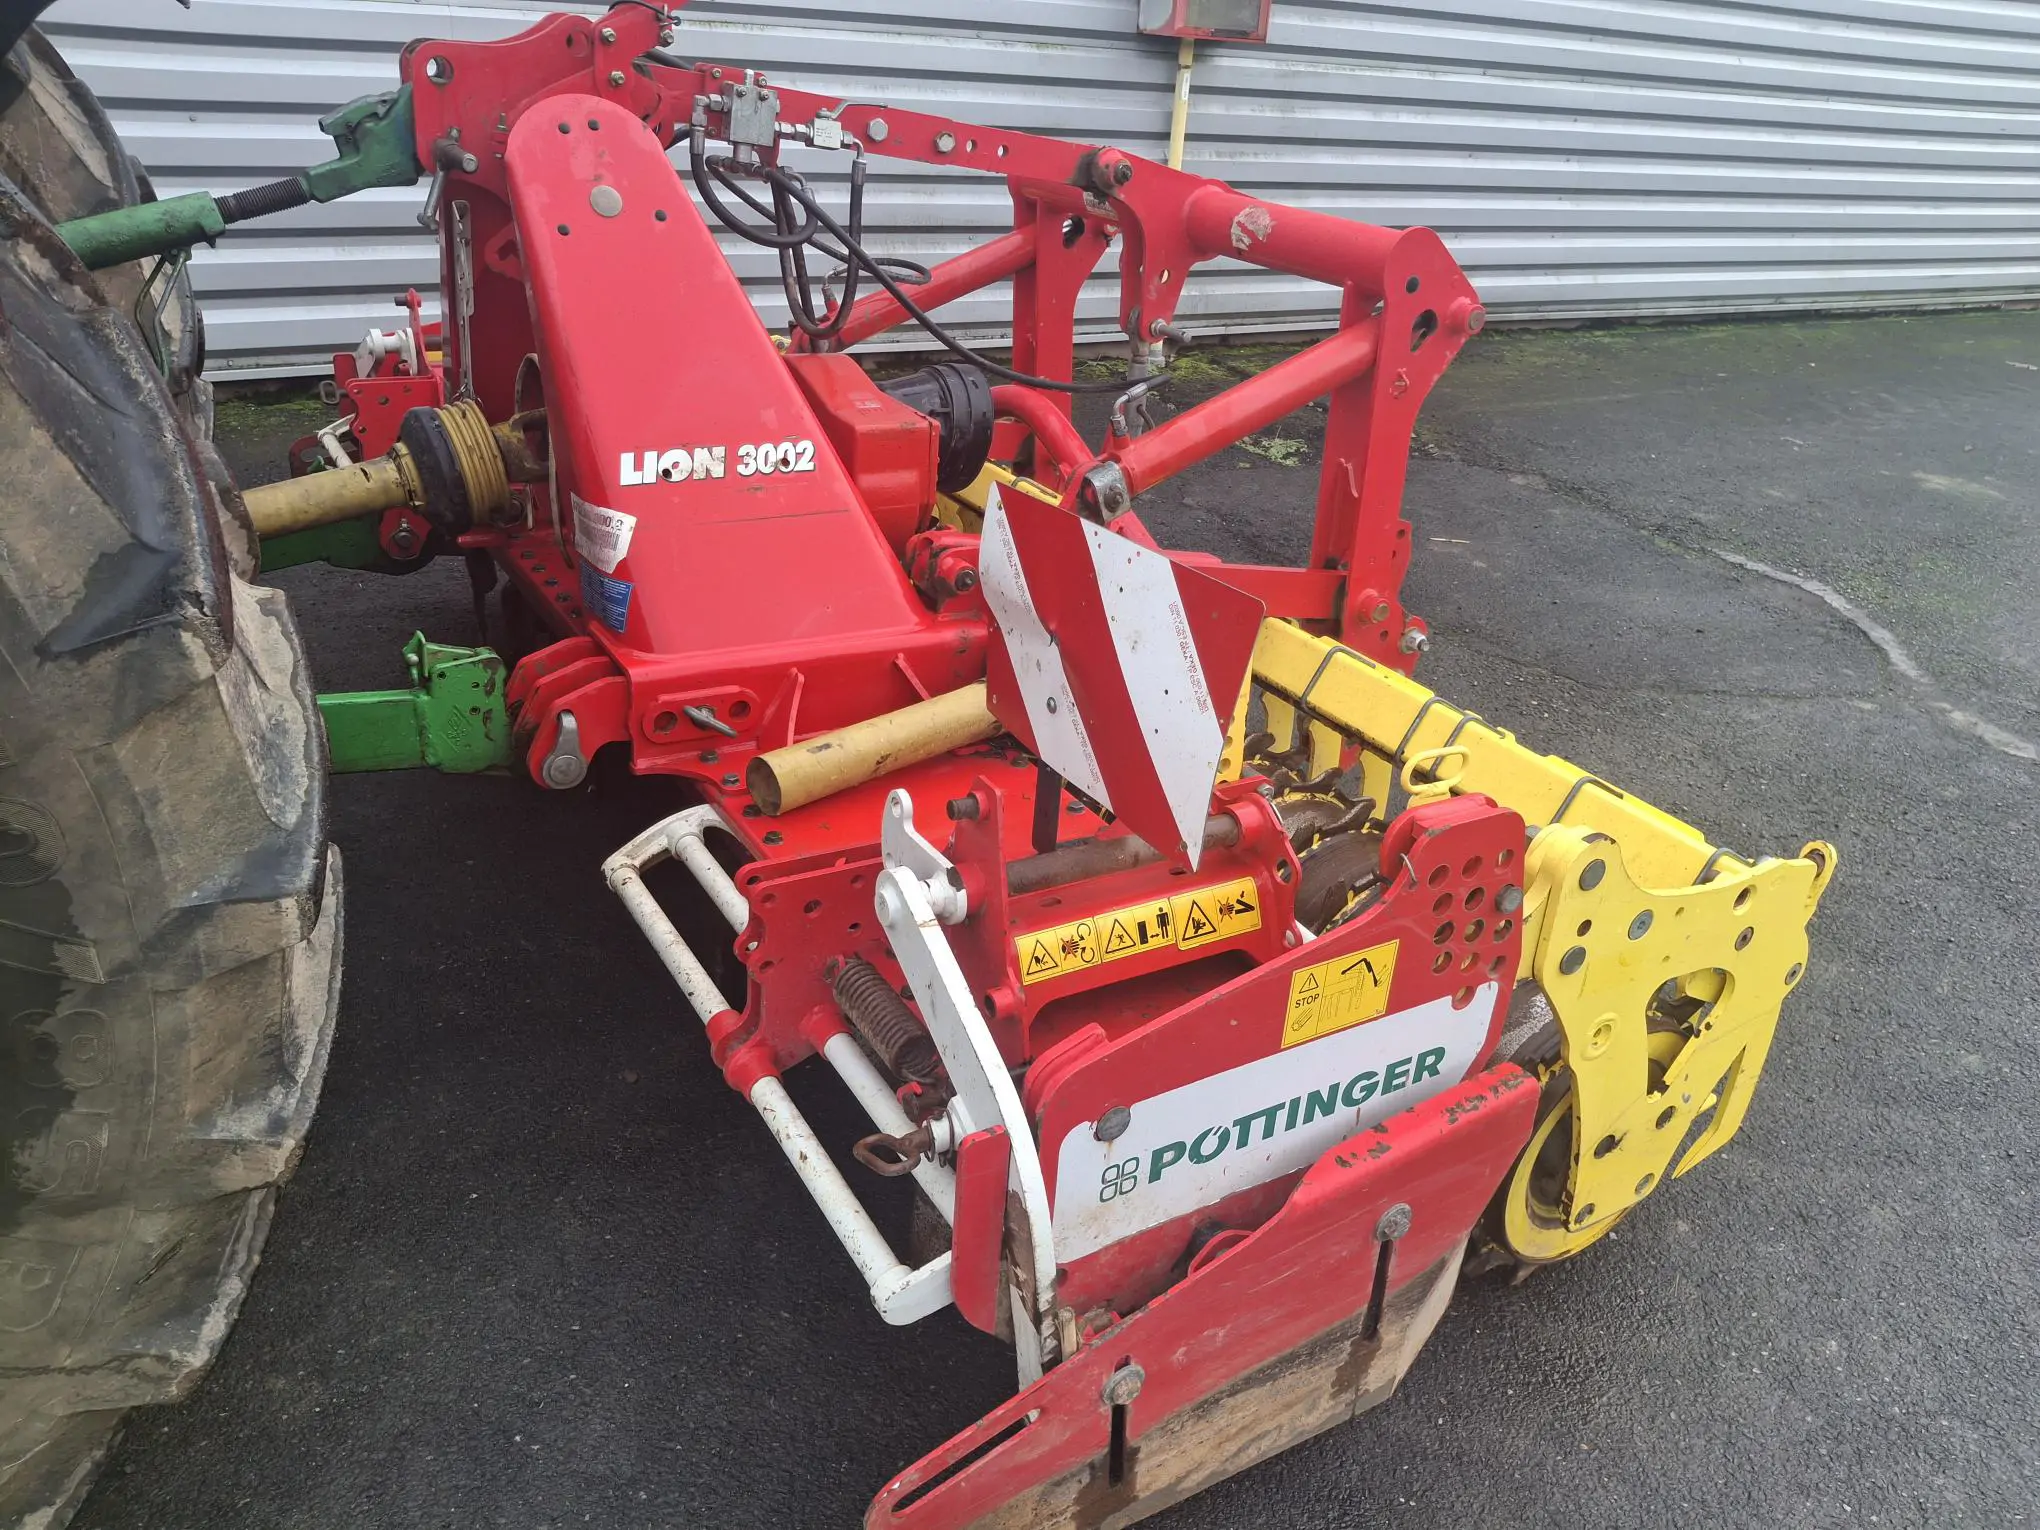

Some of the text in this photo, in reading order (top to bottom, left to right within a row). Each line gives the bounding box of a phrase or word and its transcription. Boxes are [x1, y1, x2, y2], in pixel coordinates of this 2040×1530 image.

[620, 440, 815, 486] LION 3002
[1294, 993, 1320, 1009] STOP
[1147, 1046, 1446, 1185] PÖTTINGER
